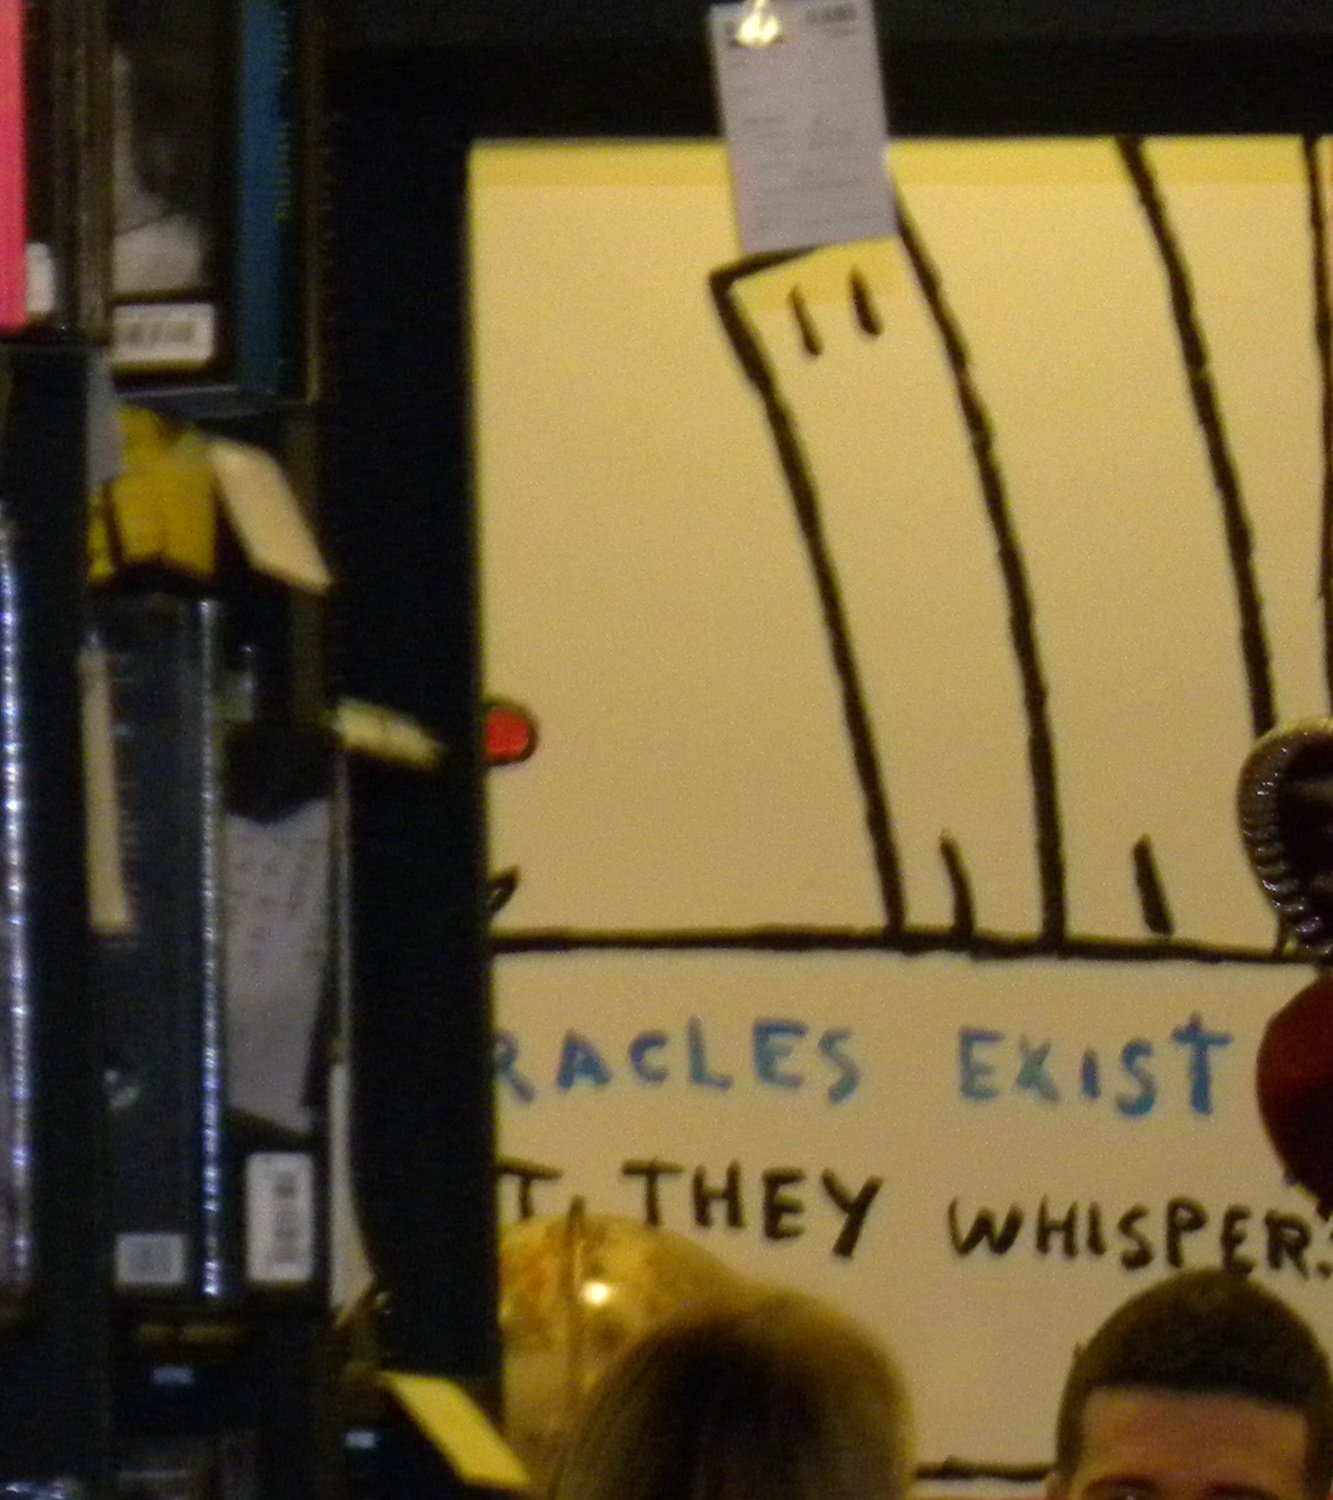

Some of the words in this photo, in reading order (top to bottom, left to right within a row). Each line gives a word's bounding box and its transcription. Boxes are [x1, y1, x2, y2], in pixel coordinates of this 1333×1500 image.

[494, 1015, 863, 1104] RACLES
[957, 1011, 1233, 1116] EXIST
[620, 1154, 885, 1259] THEY
